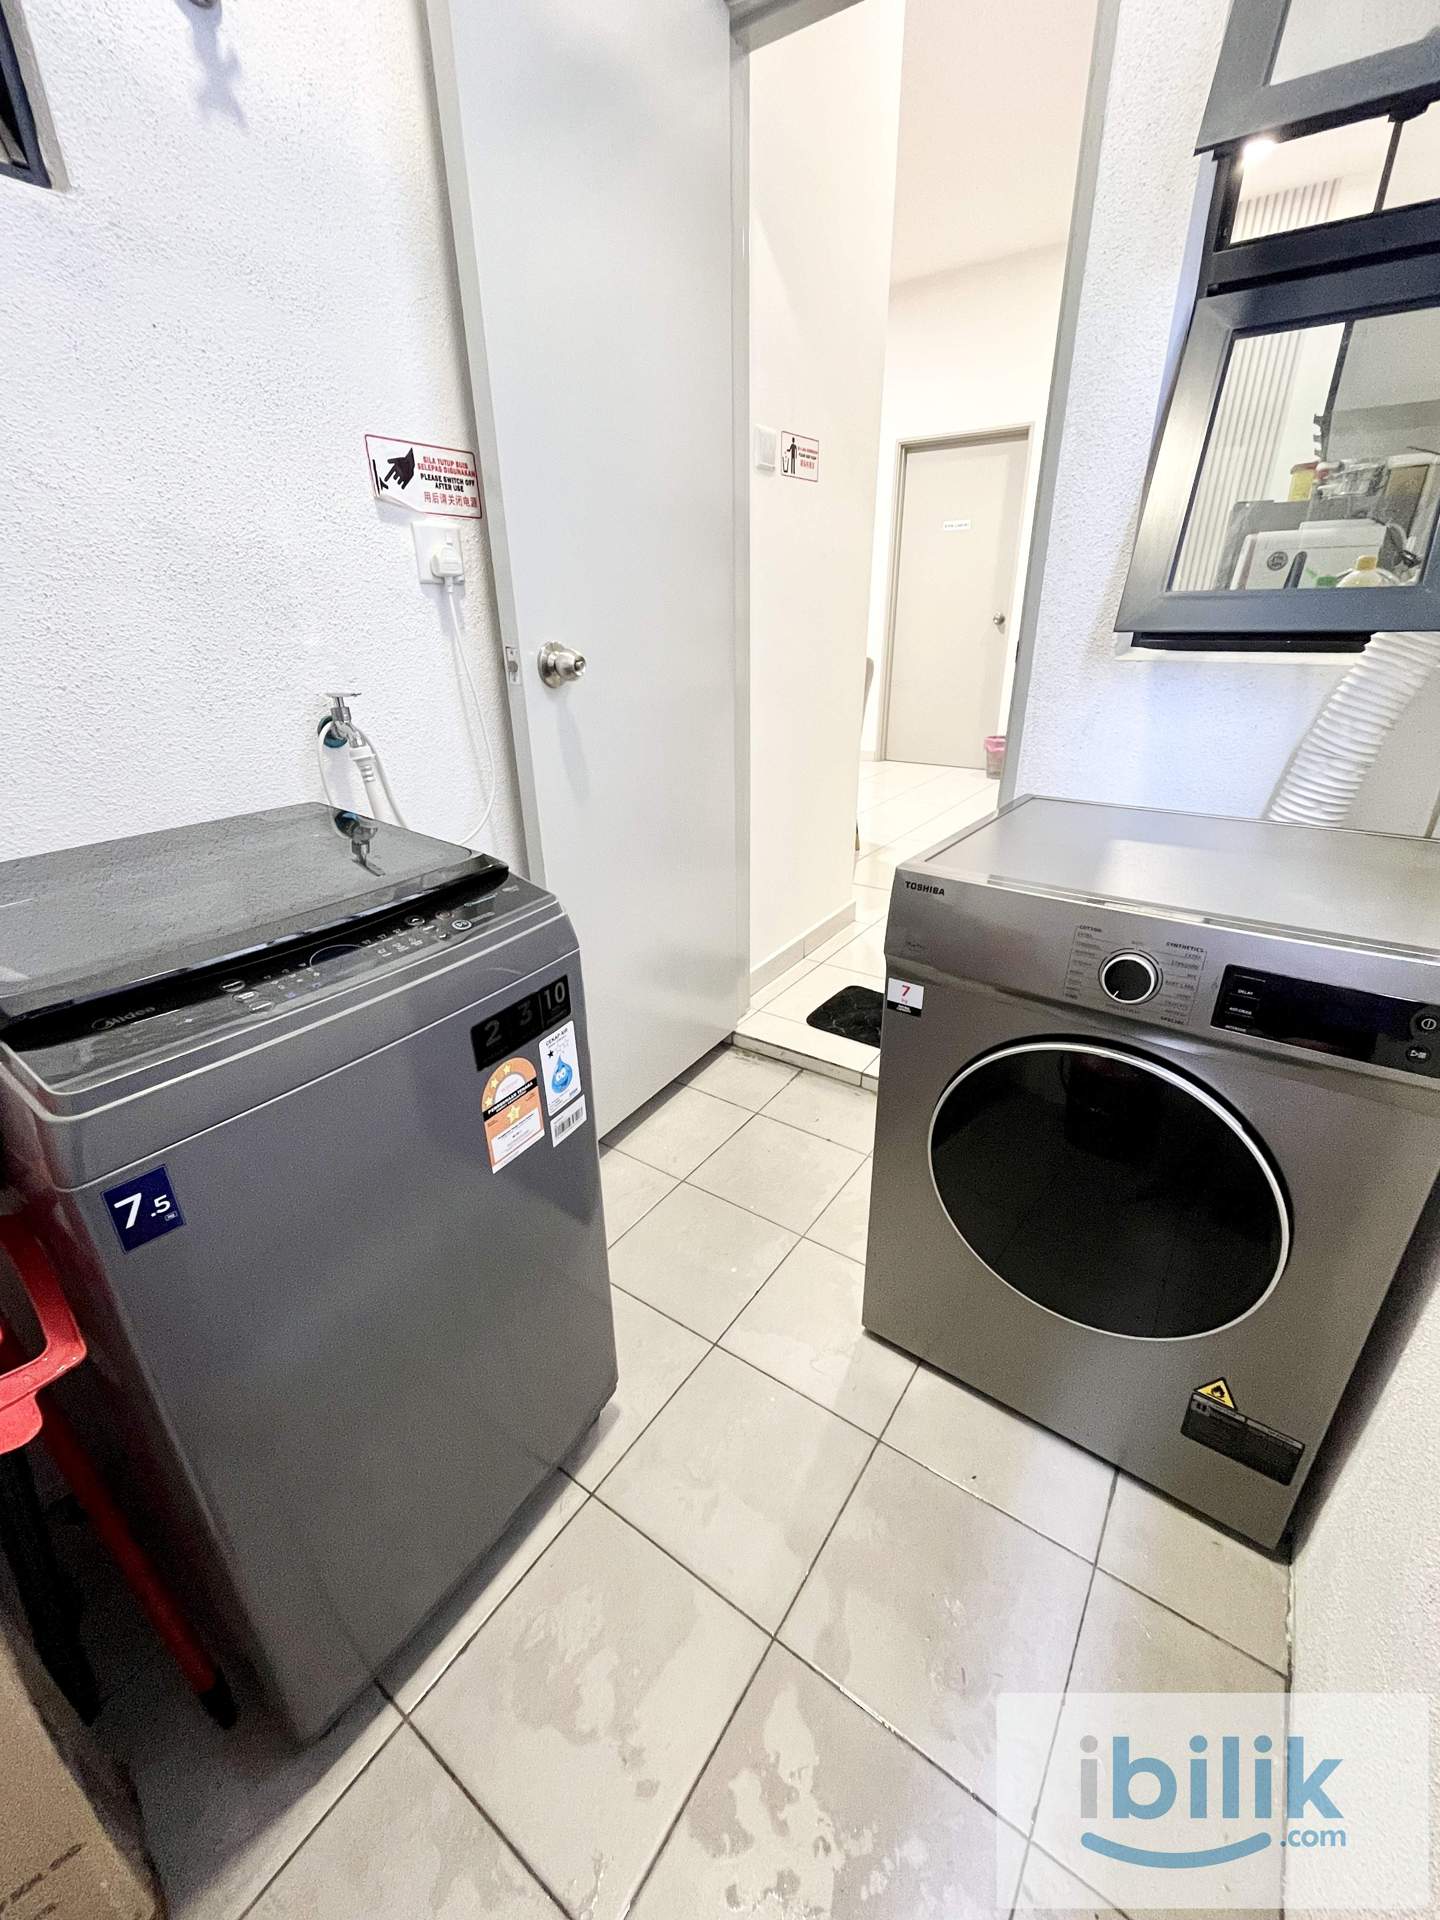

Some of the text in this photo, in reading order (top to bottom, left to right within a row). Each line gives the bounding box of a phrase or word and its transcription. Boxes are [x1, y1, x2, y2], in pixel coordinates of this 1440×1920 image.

[420, 473, 442, 482] PLEASE
[443, 476, 464, 485] SWITCH
[905, 881, 945, 896] TOSHIBA
[902, 985, 910, 997] 7
[485, 1019, 502, 1047] 2
[518, 1000, 533, 1026] 3
[544, 982, 566, 1010] 10
